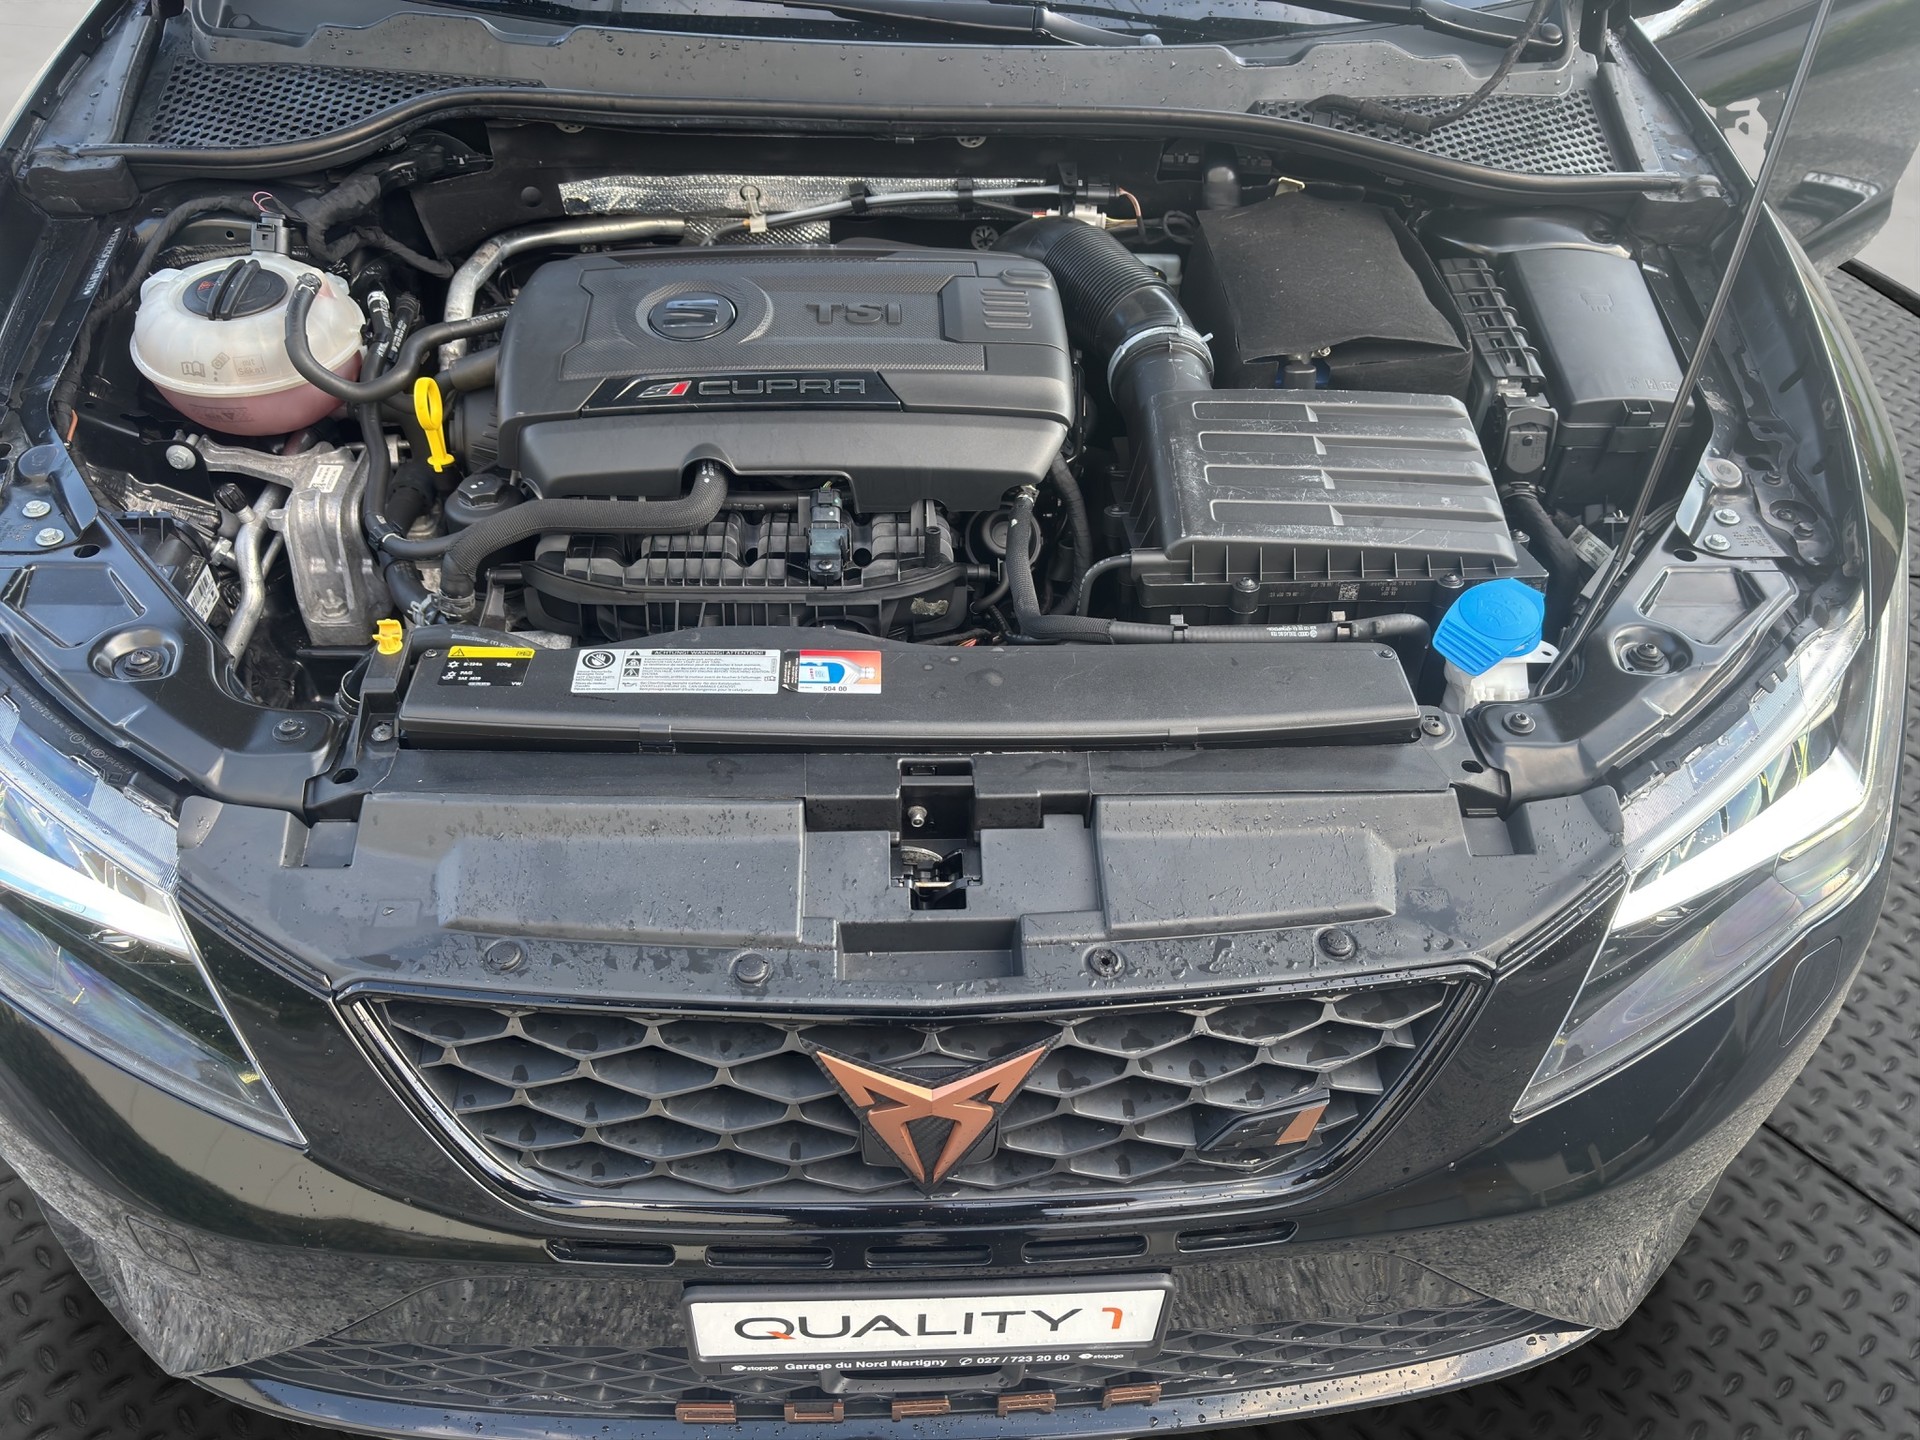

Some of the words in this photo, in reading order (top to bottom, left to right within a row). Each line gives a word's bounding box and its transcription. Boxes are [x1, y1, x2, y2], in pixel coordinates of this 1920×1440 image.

[806, 303, 902, 323] TSI
[698, 378, 866, 396] CUPRA
[734, 1308, 1083, 1340] QUALITY
[1102, 1307, 1123, 1330] 1
[785, 1363, 831, 1371] Garage
[835, 1361, 852, 1369] du
[891, 1358, 948, 1368] Martigny
[977, 1357, 999, 1365] 027
